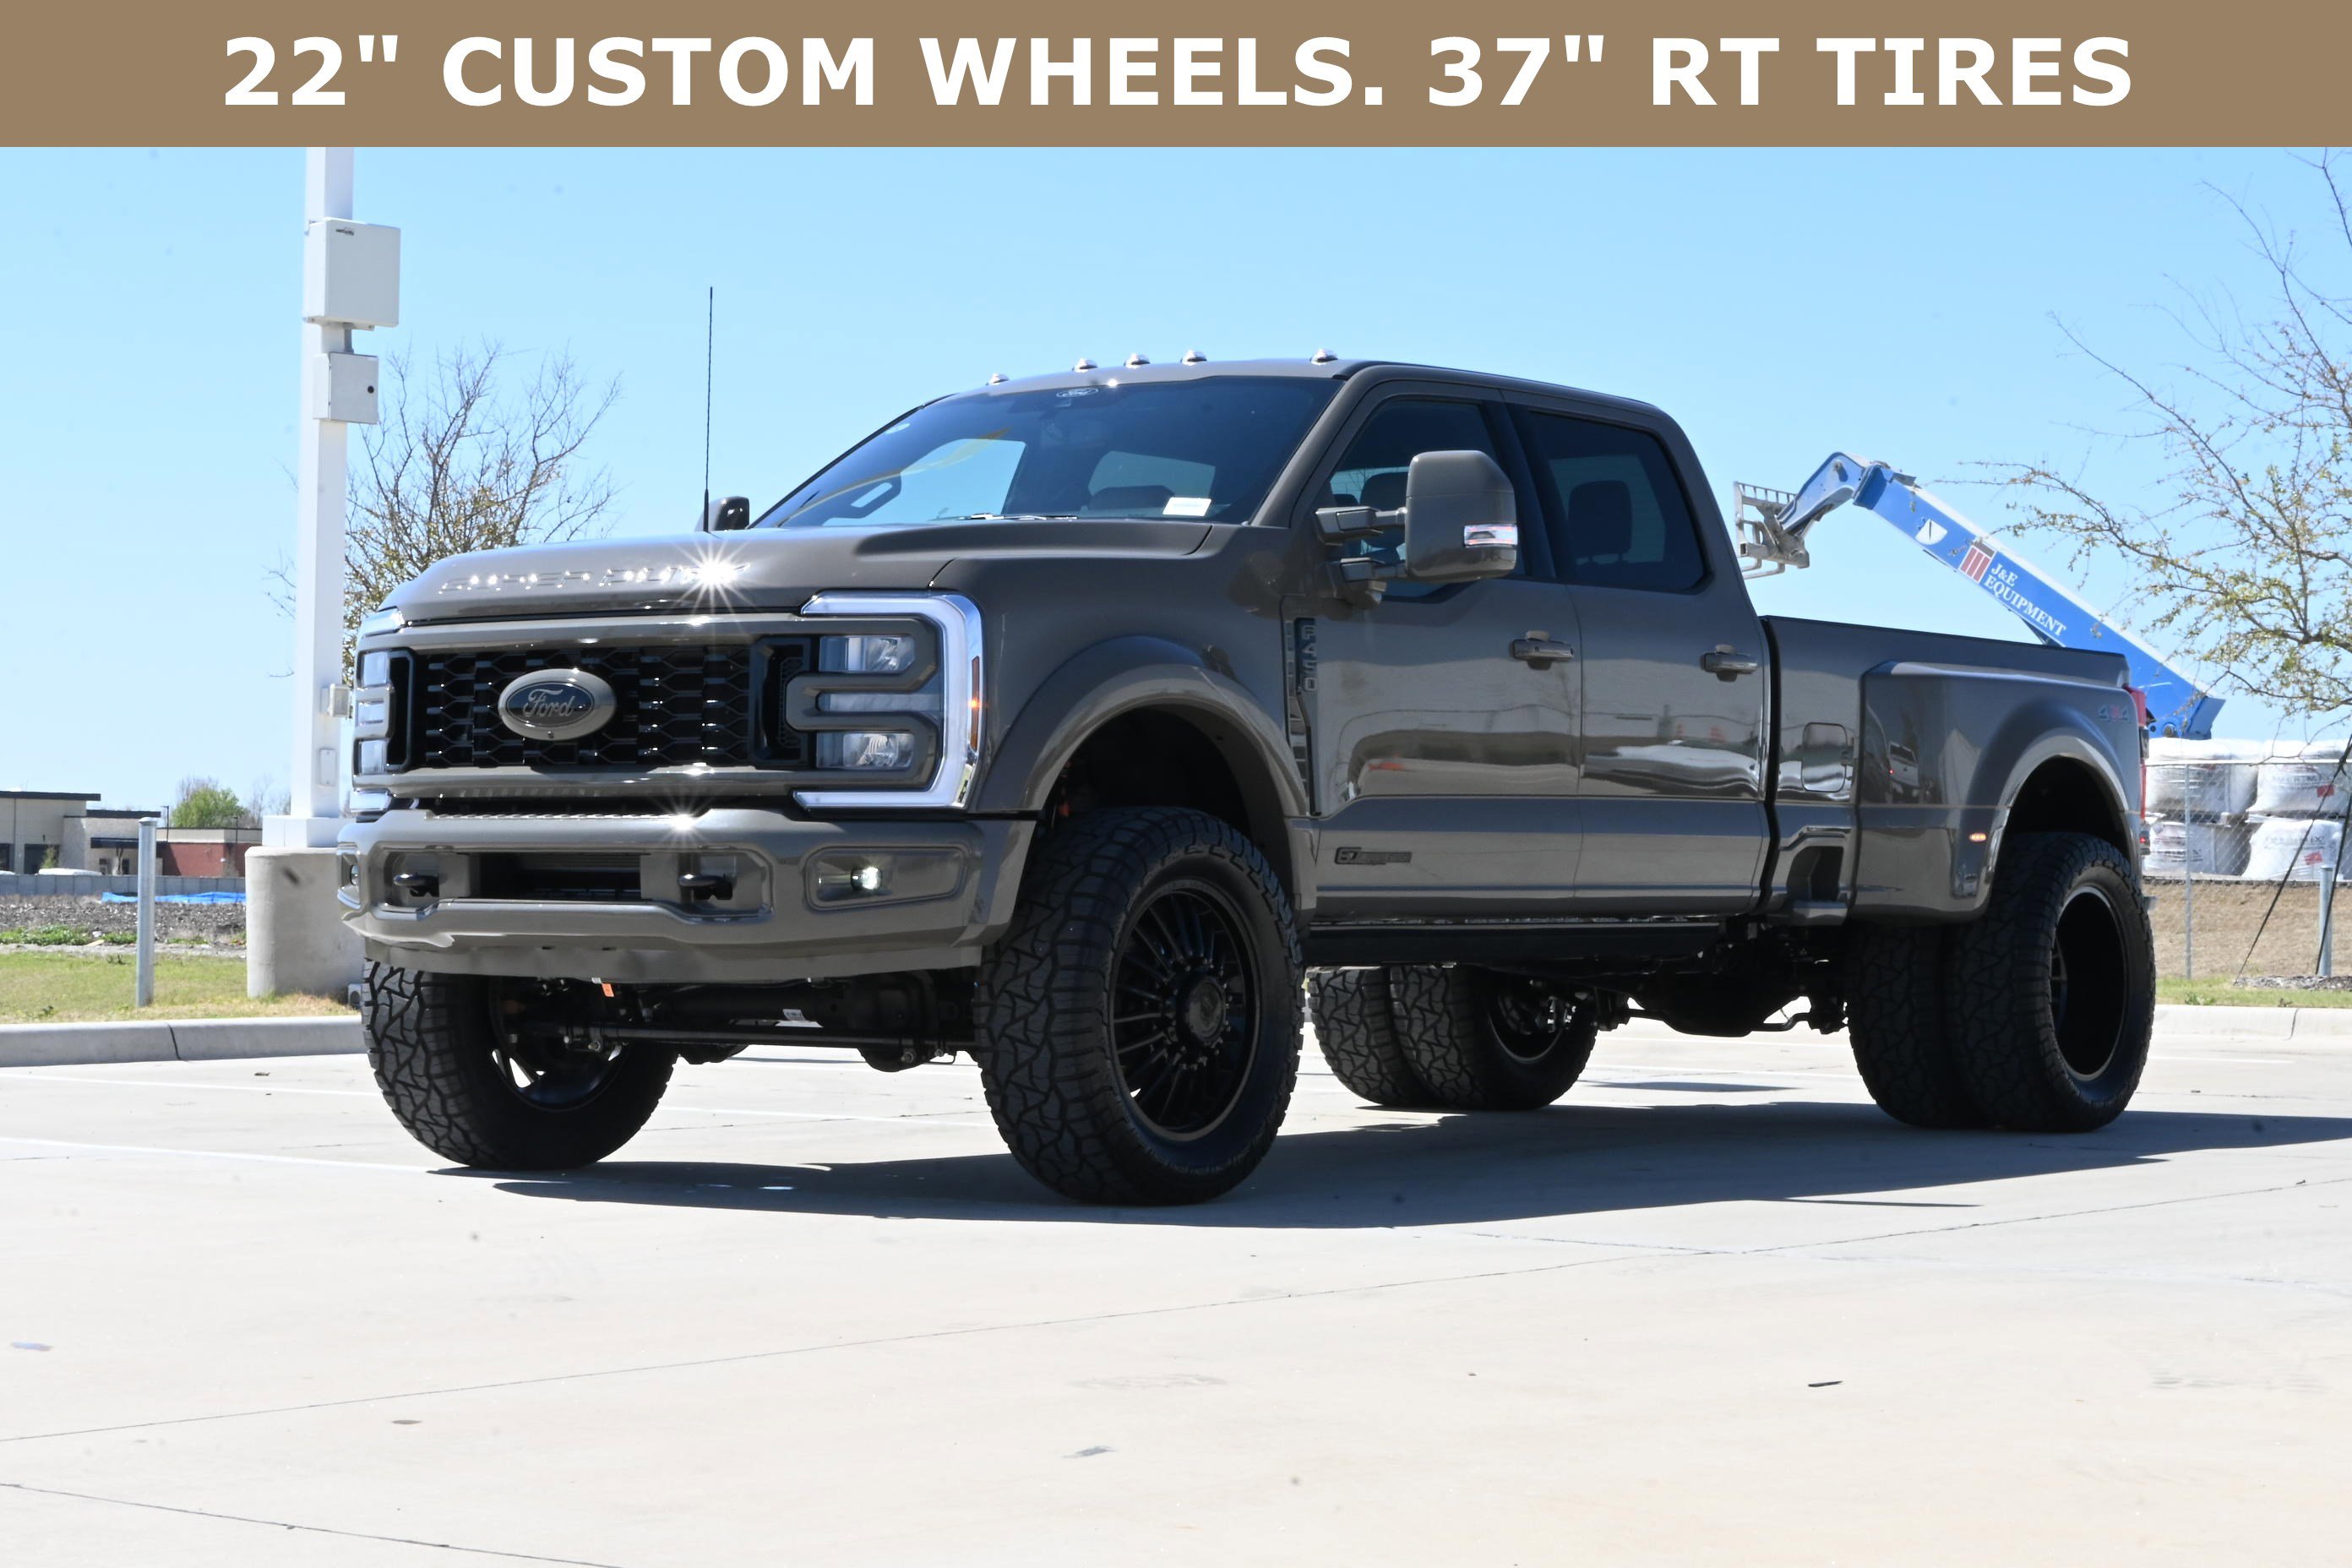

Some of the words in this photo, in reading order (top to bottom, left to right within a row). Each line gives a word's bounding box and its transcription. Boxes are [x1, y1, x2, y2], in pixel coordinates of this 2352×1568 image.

[597, 563, 751, 587] DUT
[1990, 563, 2018, 586] J&E
[1984, 574, 2067, 636] EQUIPMENT
[522, 688, 576, 718] Ford
